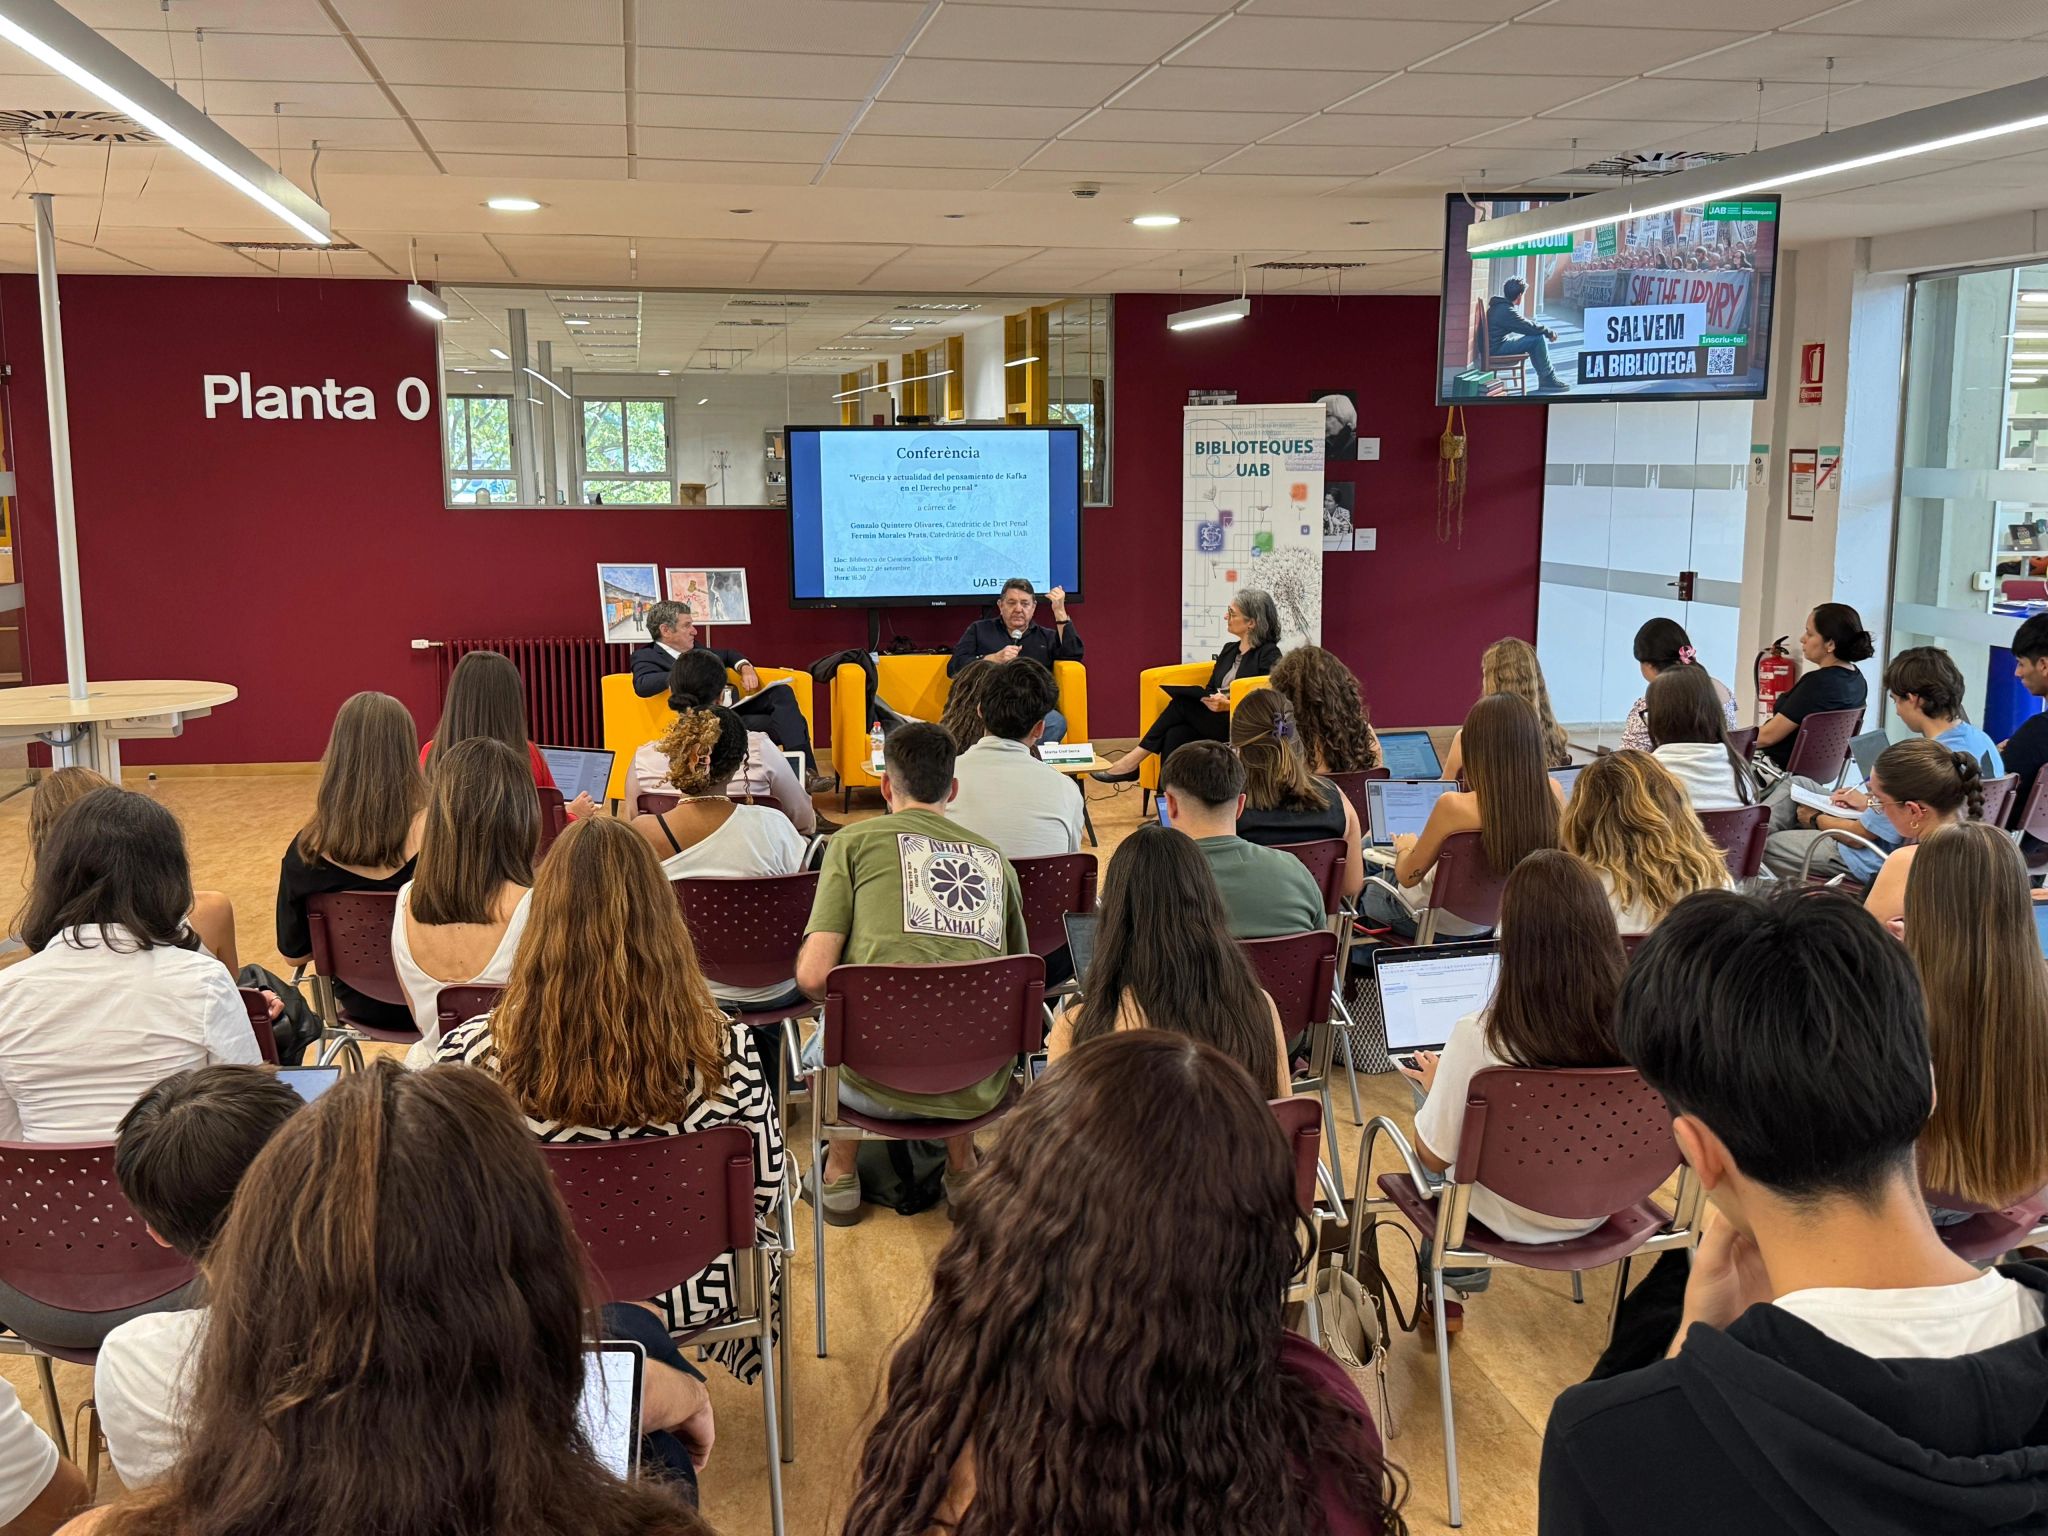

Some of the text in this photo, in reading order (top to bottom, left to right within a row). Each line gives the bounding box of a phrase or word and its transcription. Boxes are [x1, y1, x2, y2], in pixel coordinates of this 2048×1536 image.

[1606, 313, 1685, 343] SALVEM
[1701, 336, 1744, 344] Inscriu-te!
[1585, 351, 1697, 378] LA BIBLIOTECA
[203, 371, 431, 421] Planta 0
[896, 445, 981, 459] Conferència
[1195, 439, 1314, 456] BIBLIOTEQUES
[887, 475, 892, 483] y
[893, 472, 932, 481] actualidad
[933, 473, 945, 481] del
[946, 472, 994, 482] pensamiento
[995, 472, 1004, 480] de
[1006, 472, 1027, 480] Kafka
[1236, 463, 1271, 478] UAB
[911, 484, 918, 492] el
[920, 484, 951, 492] Derecho
[952, 483, 973, 494] penal
[947, 503, 957, 511] de
[850, 522, 879, 530] Gonzalo
[880, 521, 913, 530] Quintero
[914, 520, 945, 530] Olivares,
[982, 520, 992, 528] de
[993, 520, 1008, 528] Dret
[966, 530, 976, 538] de
[976, 530, 992, 538] Dret
[973, 578, 998, 588] UAB
[928, 838, 978, 862] INHALE
[934, 908, 986, 938] EXHALE
